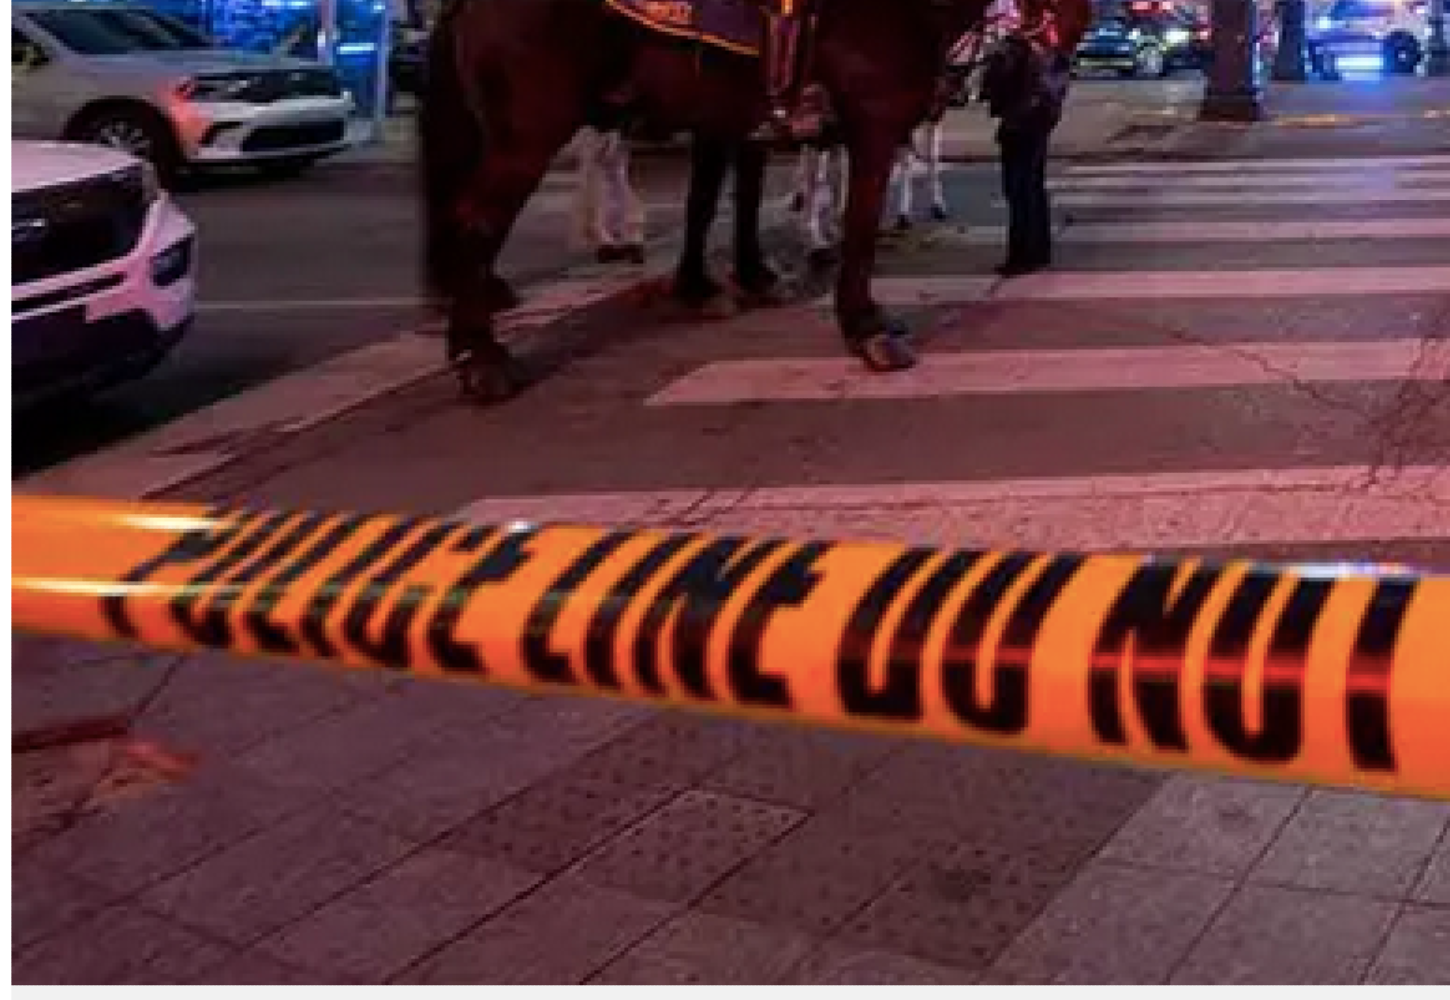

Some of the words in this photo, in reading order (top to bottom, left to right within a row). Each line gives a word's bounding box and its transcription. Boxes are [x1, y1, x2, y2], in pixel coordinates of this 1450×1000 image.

[98, 504, 535, 673] POLICE
[518, 524, 832, 708] LINE
[836, 545, 1086, 736] DO
[1086, 553, 1421, 773] NOT
